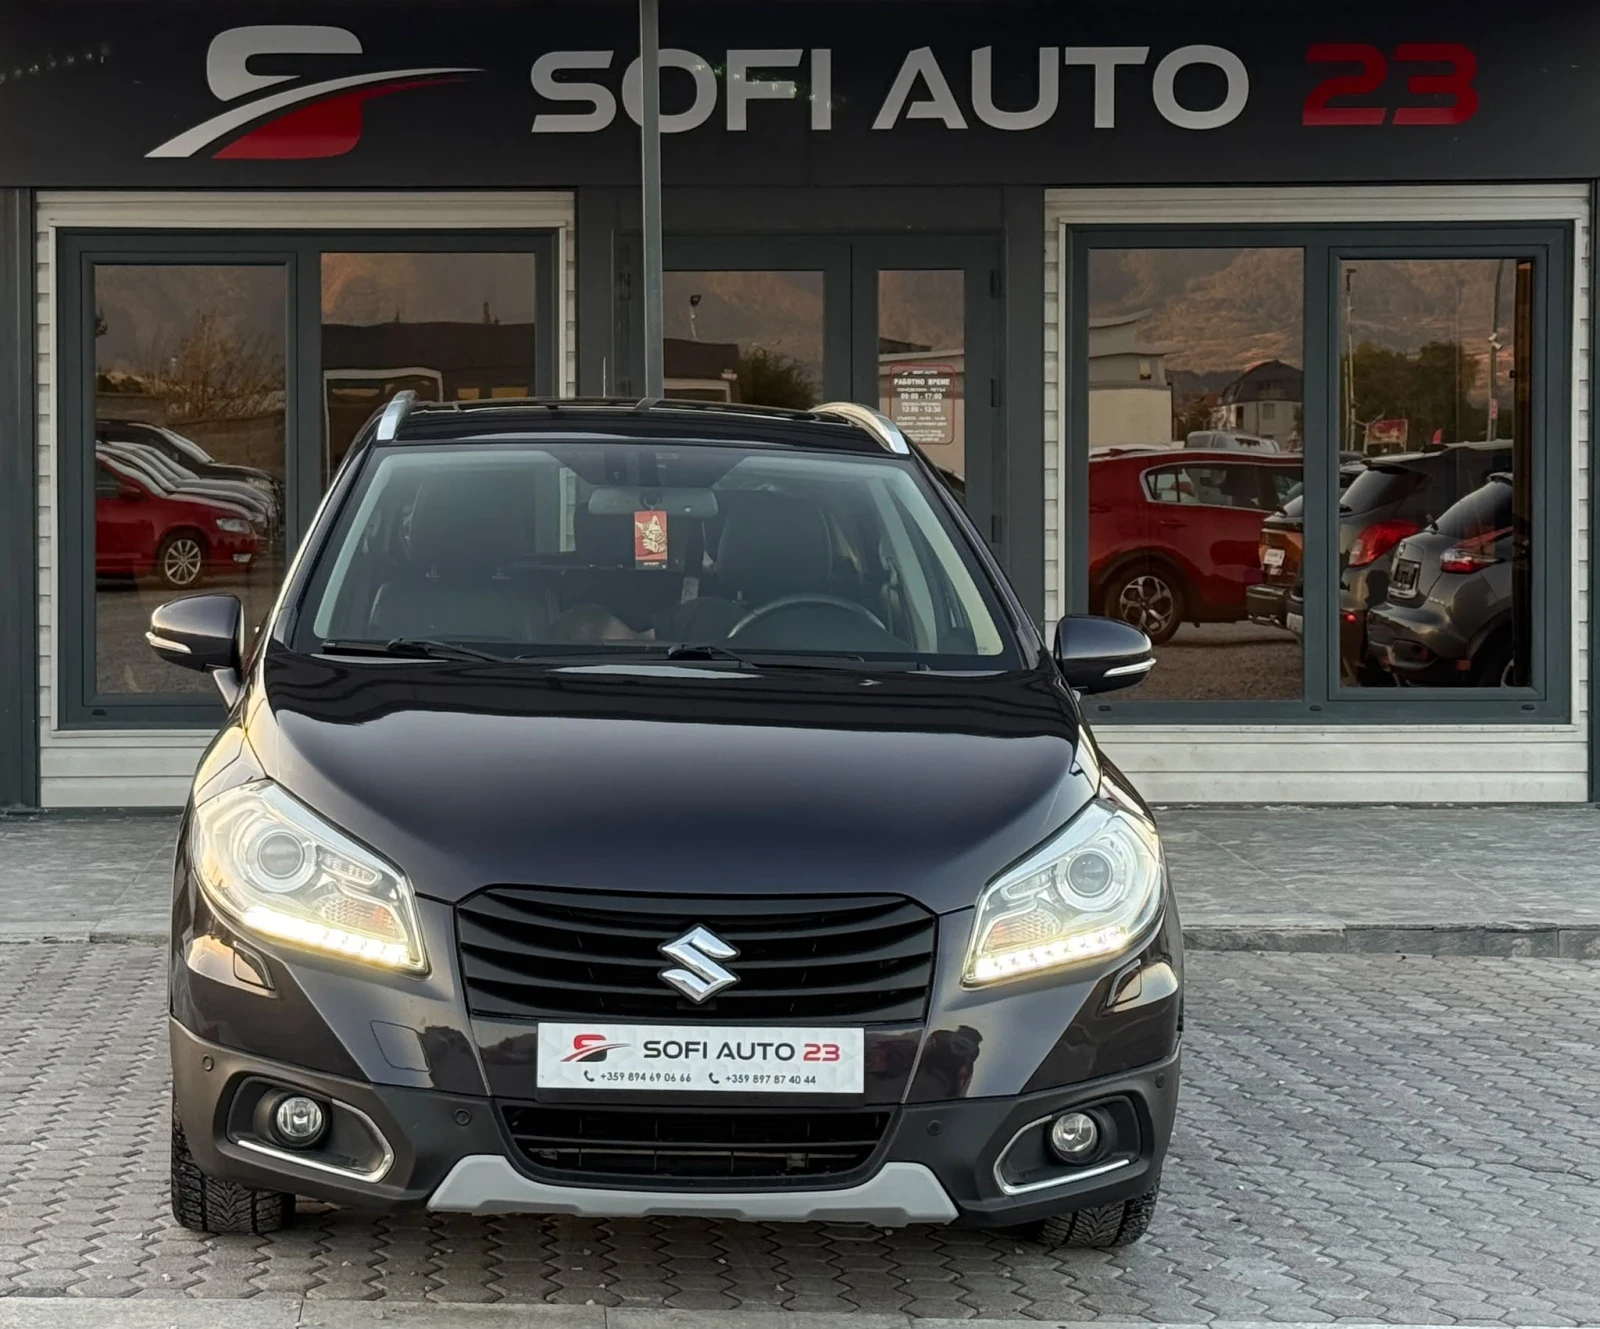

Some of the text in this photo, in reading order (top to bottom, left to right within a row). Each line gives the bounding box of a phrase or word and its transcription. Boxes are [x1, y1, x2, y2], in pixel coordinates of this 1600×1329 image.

[530, 42, 1480, 134] SOFI AUTO 23
[894, 378, 951, 386] РАБОТНО ВРЕМЕ
[643, 1040, 841, 1062] SOFI AUTO 23
[600, 1071, 692, 1083] +359 894 69 06 66
[725, 1074, 816, 1085] +359 897 87 40 44
